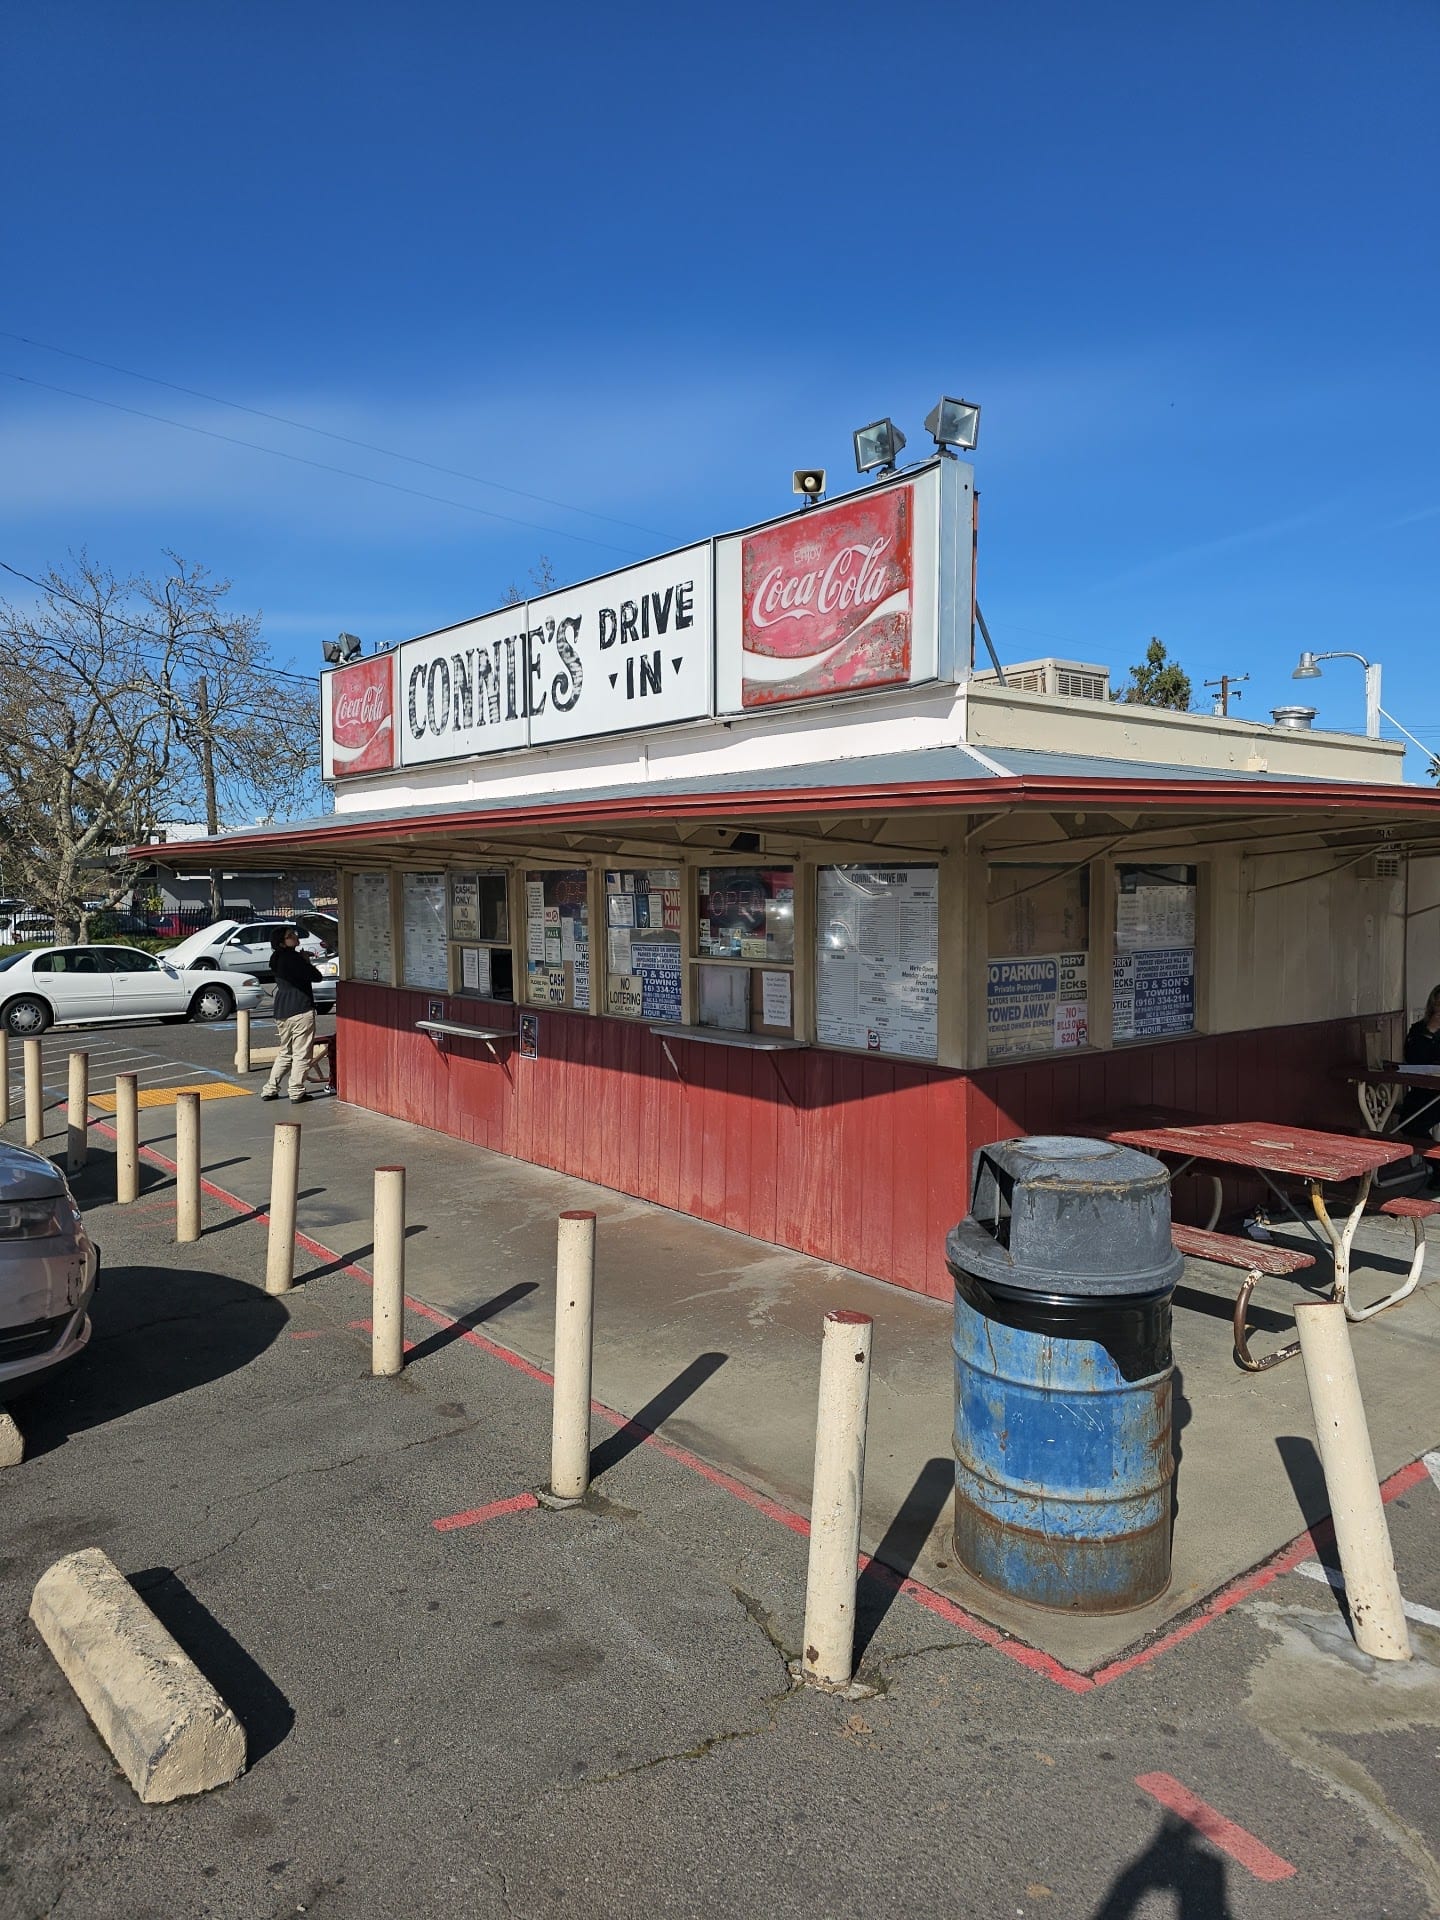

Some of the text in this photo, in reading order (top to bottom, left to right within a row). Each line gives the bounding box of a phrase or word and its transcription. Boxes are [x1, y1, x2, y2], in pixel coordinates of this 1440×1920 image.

[793, 545, 822, 564] Enjoy
[599, 580, 694, 650] DRIVE
[408, 613, 584, 740] CONNIE'S
[626, 650, 662, 700] IN
[455, 896, 471, 905] ONLY
[650, 970, 657, 978] &
[1001, 963, 1055, 982] PARKING
[1113, 968, 1125, 978] NO
[549, 974, 565, 986] CASH
[620, 977, 631, 990] NO
[645, 978, 678, 987] TOWING
[1136, 977, 1190, 990] ED & SON'S
[549, 988, 565, 1001] ONLY
[994, 983, 1042, 993] Private Property
[1144, 987, 1182, 997] TOWING
[609, 991, 641, 1006] LOITERING
[1136, 994, 1190, 1007] (916) 334-2111
[988, 1002, 1050, 1023] TOWED AWAY
[1066, 1007, 1077, 1018] NO
